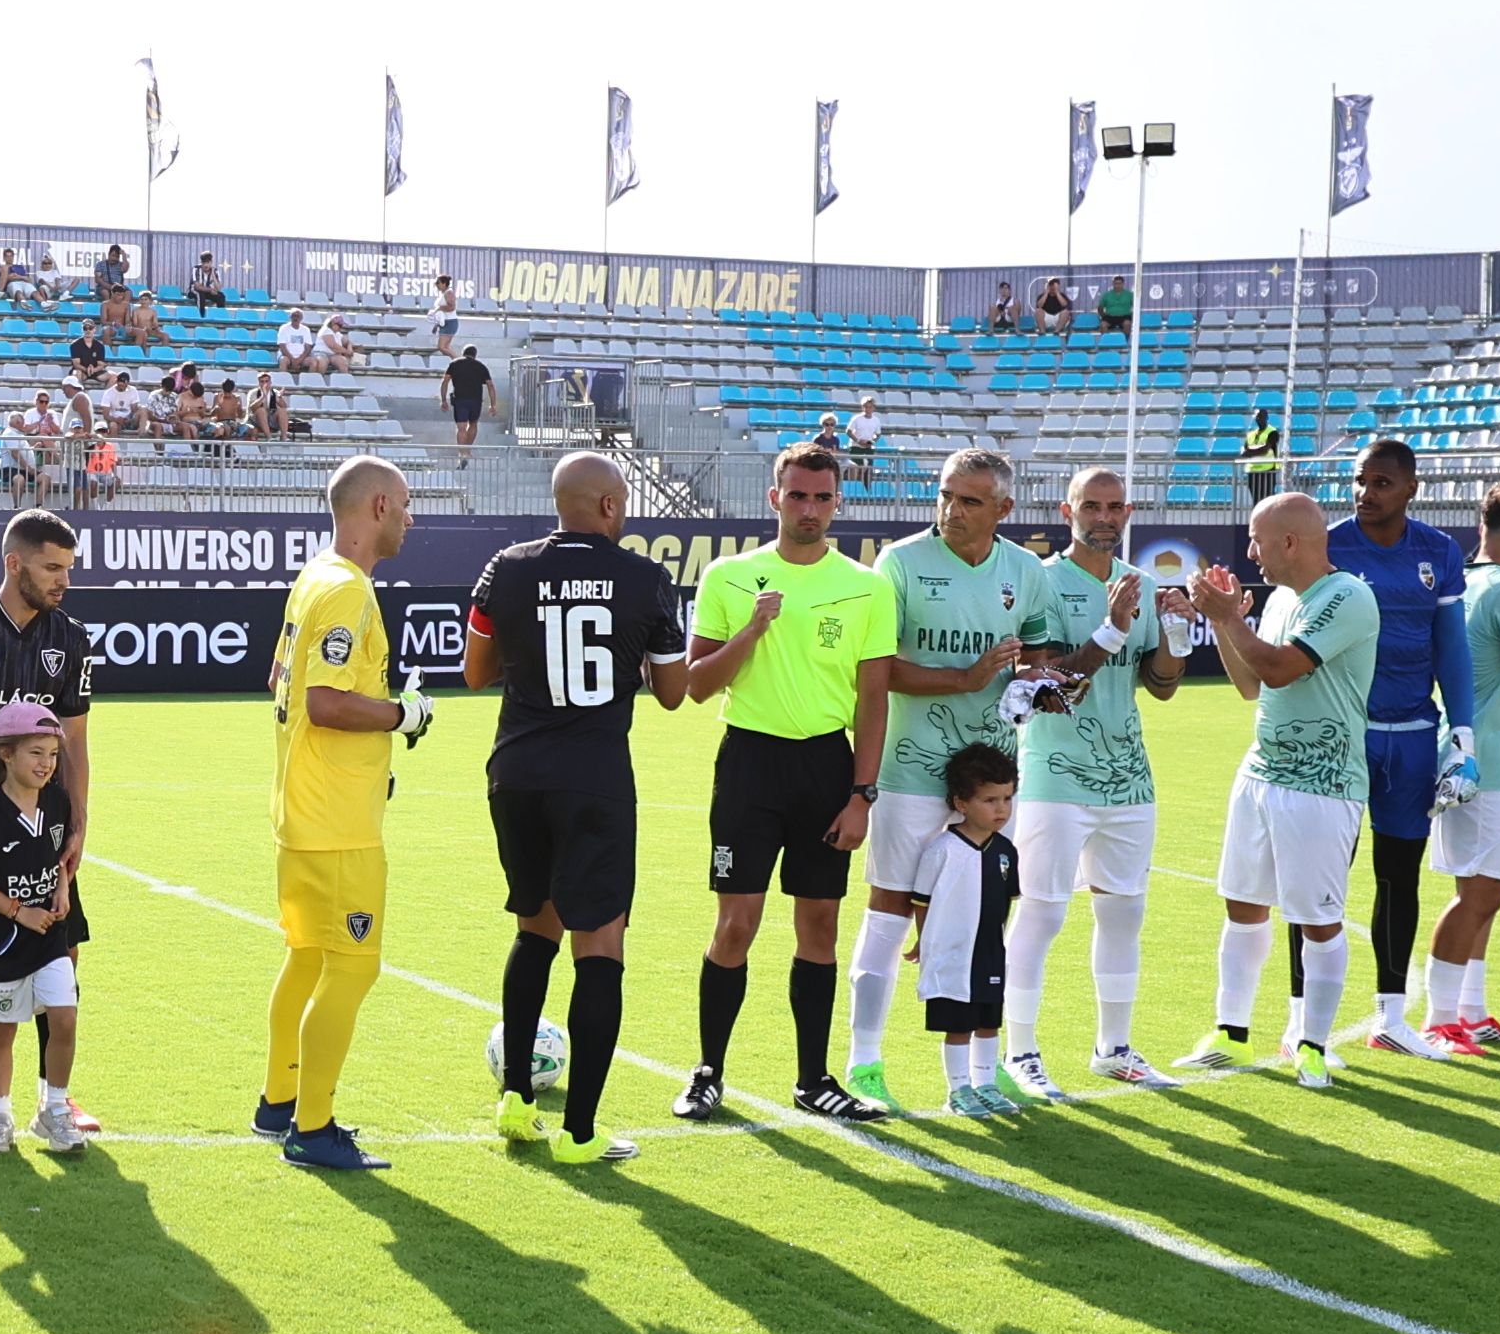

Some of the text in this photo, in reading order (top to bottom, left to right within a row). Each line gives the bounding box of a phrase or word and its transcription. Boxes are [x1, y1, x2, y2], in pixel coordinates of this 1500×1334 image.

[306, 251, 441, 276] NUM UNIVERSO EM
[346, 275, 476, 299] QUE AS ESTRAS
[490, 259, 801, 314] JOGAM NA NAZARÉ
[103, 529, 274, 571] UNIVERSO
[285, 530, 332, 571] EM
[538, 580, 613, 601] M. ABREU
[401, 621, 465, 656] MB
[537, 605, 614, 707] 16
[8, 887, 34, 899] DO
